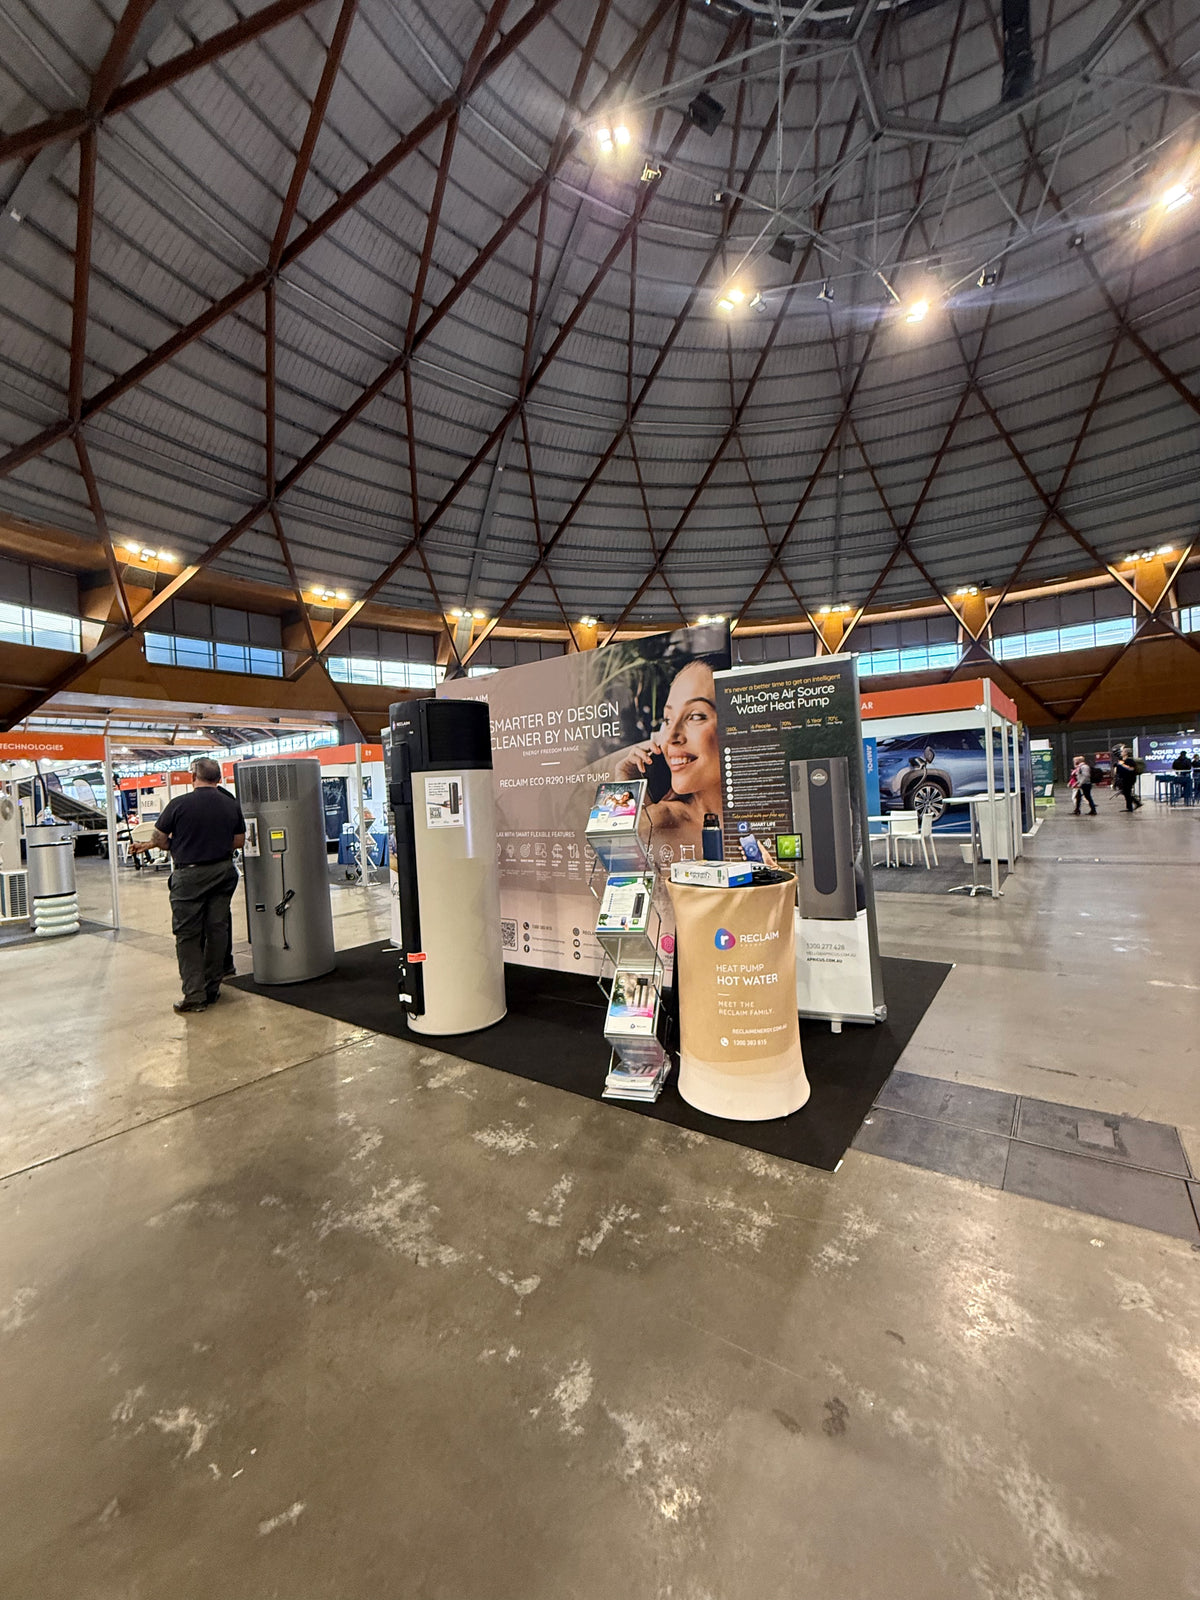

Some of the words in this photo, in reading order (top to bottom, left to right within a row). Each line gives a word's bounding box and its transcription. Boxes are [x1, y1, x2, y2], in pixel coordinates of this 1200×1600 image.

[812, 674, 840, 682] intelligent
[730, 691, 780, 705] All-In-One
[782, 688, 796, 699] Air
[797, 684, 835, 697] Source
[736, 704, 768, 715] Water
[770, 700, 796, 711] Heat
[798, 697, 830, 708] Pump
[490, 713, 544, 734] SMARTER
[548, 710, 564, 726] BY
[568, 701, 619, 723] DESIGN
[490, 732, 542, 751] CLEANER
[545, 729, 560, 744] BY
[564, 721, 620, 742] NATURE
[0, 743, 64, 751] TECHNOLOGIES
[522, 749, 540, 757] ENERGY
[540, 747, 562, 755] FREEDOM
[563, 745, 579, 753] RANGE
[866, 744, 874, 774] AMPOL
[500, 778, 528, 788] RECLAIM
[530, 777, 544, 786] ECO
[546, 776, 563, 785] R290
[566, 774, 586, 784] HEAT
[587, 772, 610, 782] PUMP
[740, 930, 779, 943] RECLAIM
[716, 964, 738, 972] HEAT
[740, 963, 764, 972] PUMP
[717, 976, 740, 986] HOT
[742, 973, 778, 986] WATER
